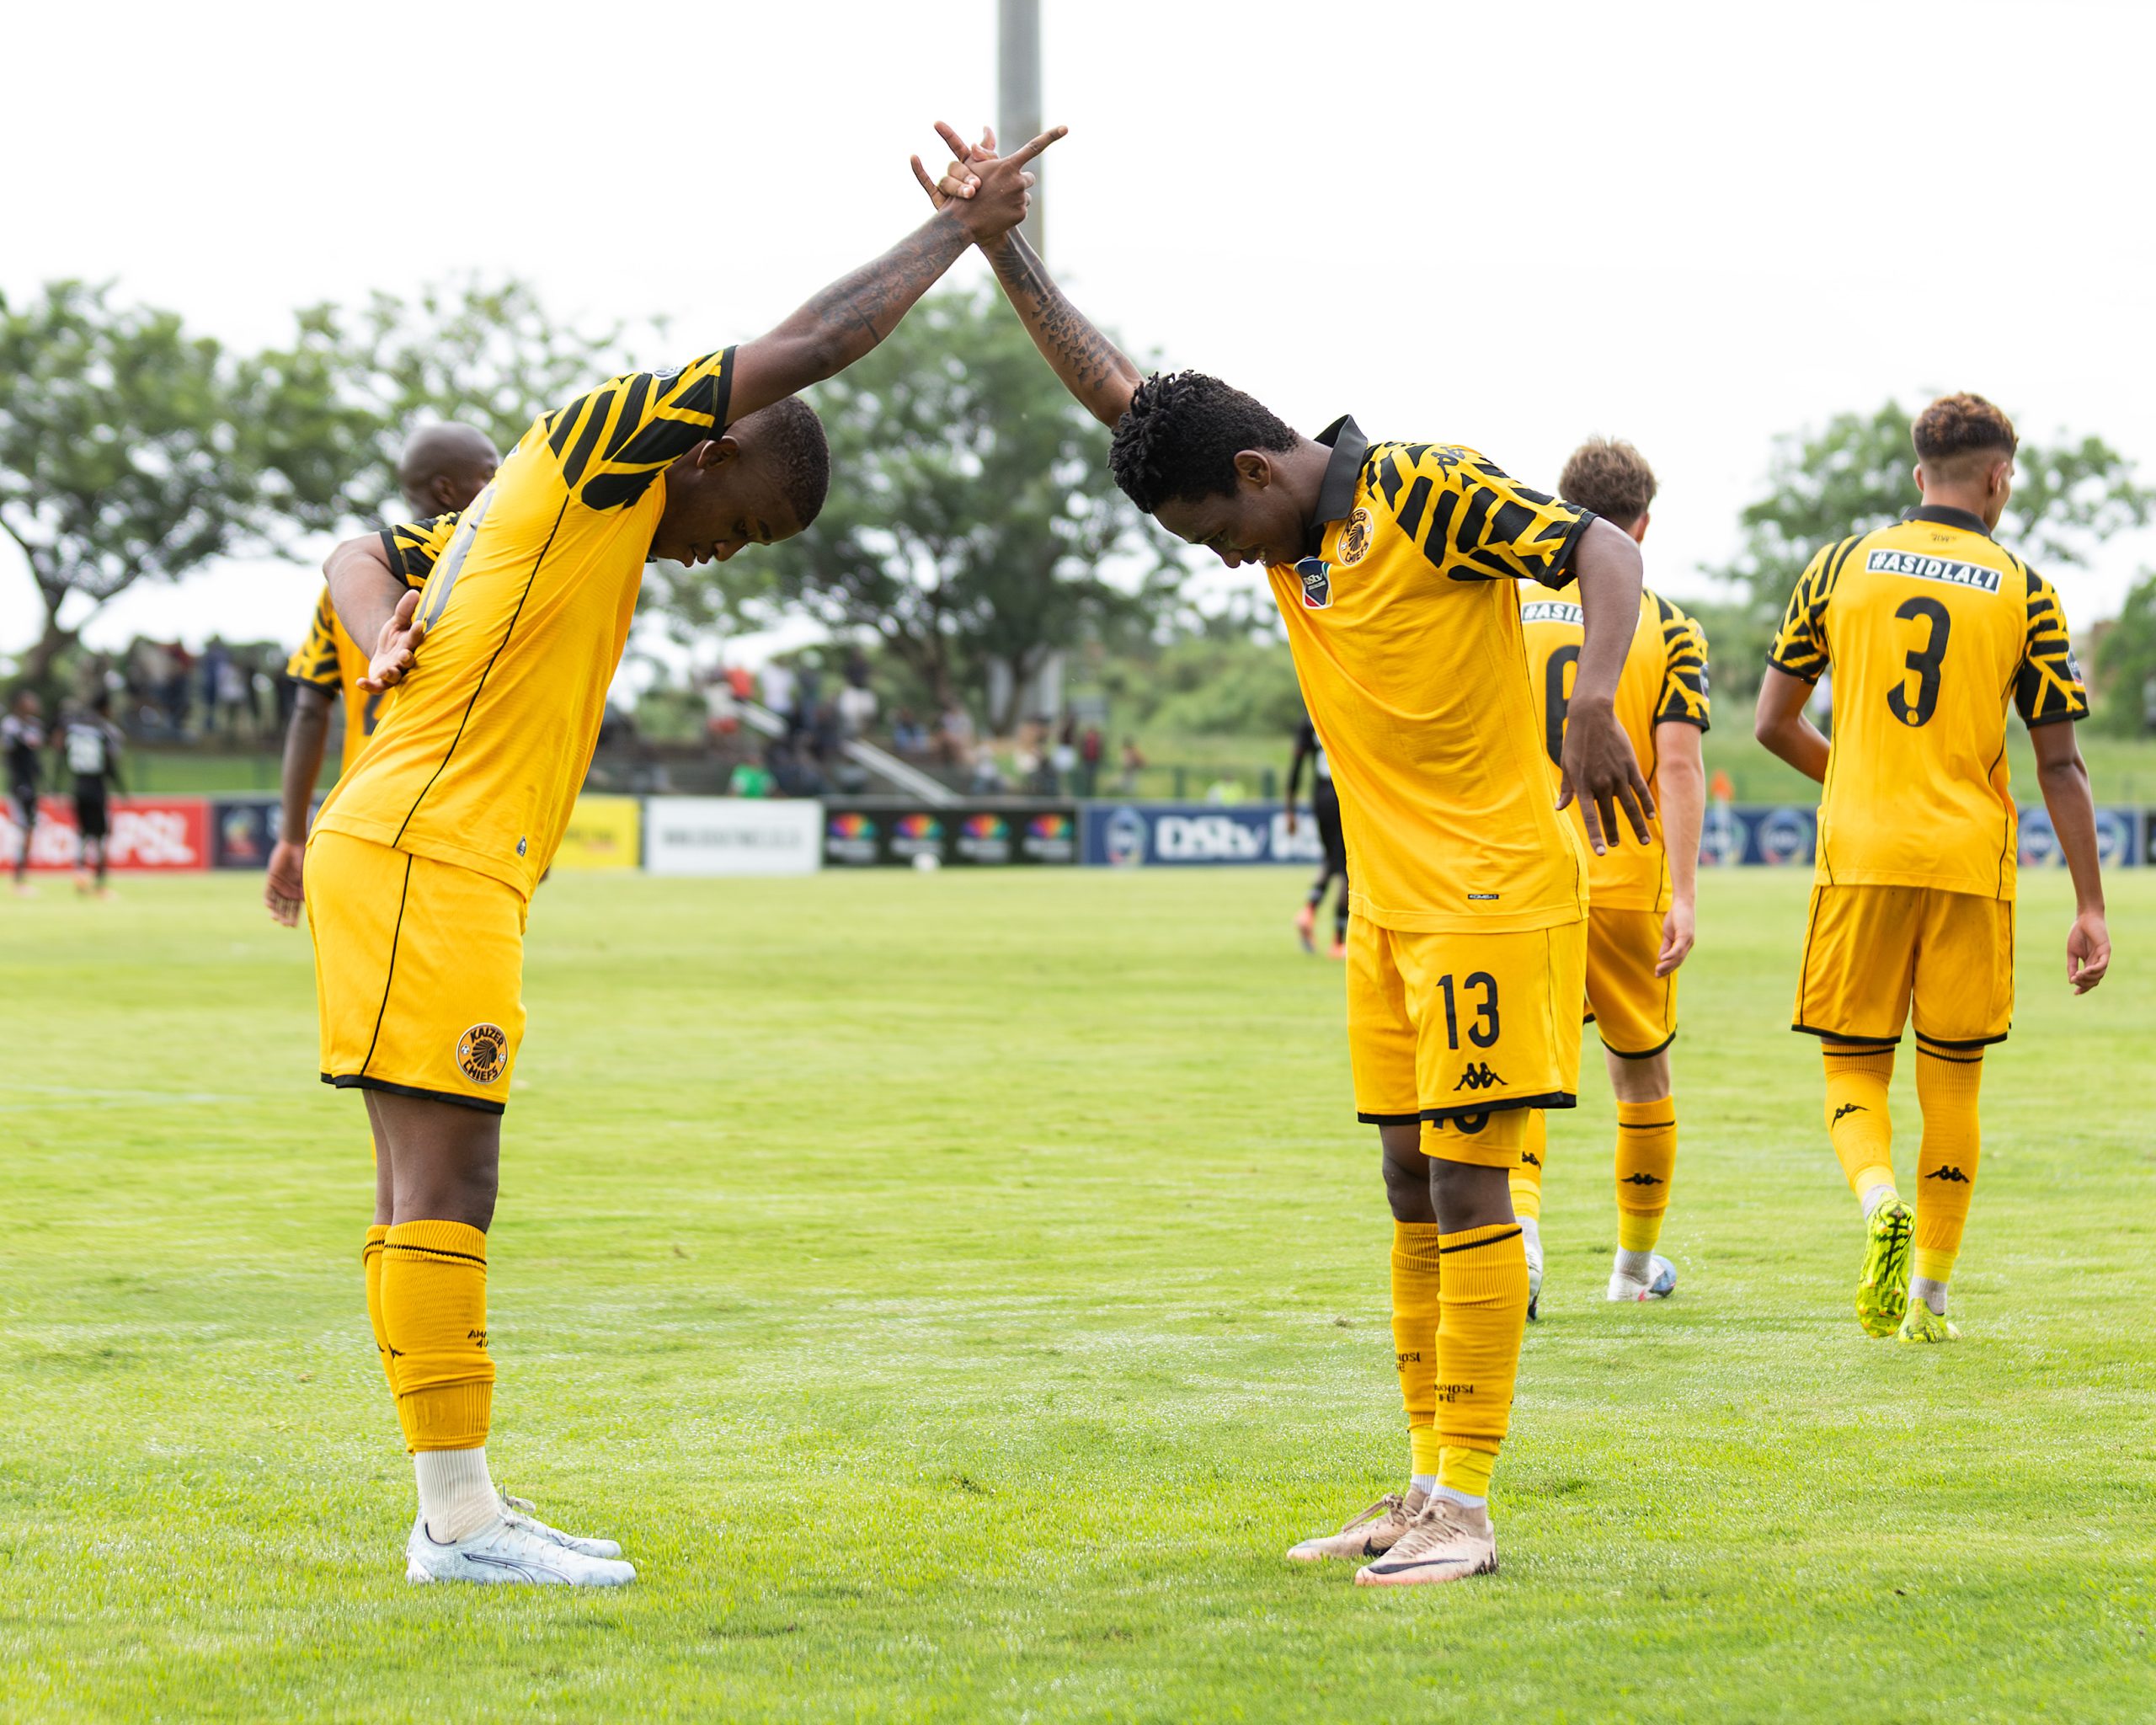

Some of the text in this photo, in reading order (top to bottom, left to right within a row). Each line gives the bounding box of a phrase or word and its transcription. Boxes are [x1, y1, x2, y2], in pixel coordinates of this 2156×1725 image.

[1872, 553, 1995, 588] #ASIDLALI
[1886, 596, 1951, 727] 3
[1437, 971, 1500, 1049] 13
[470, 1027, 504, 1048] KAIZER
[463, 1060, 498, 1081] CHIEFS
